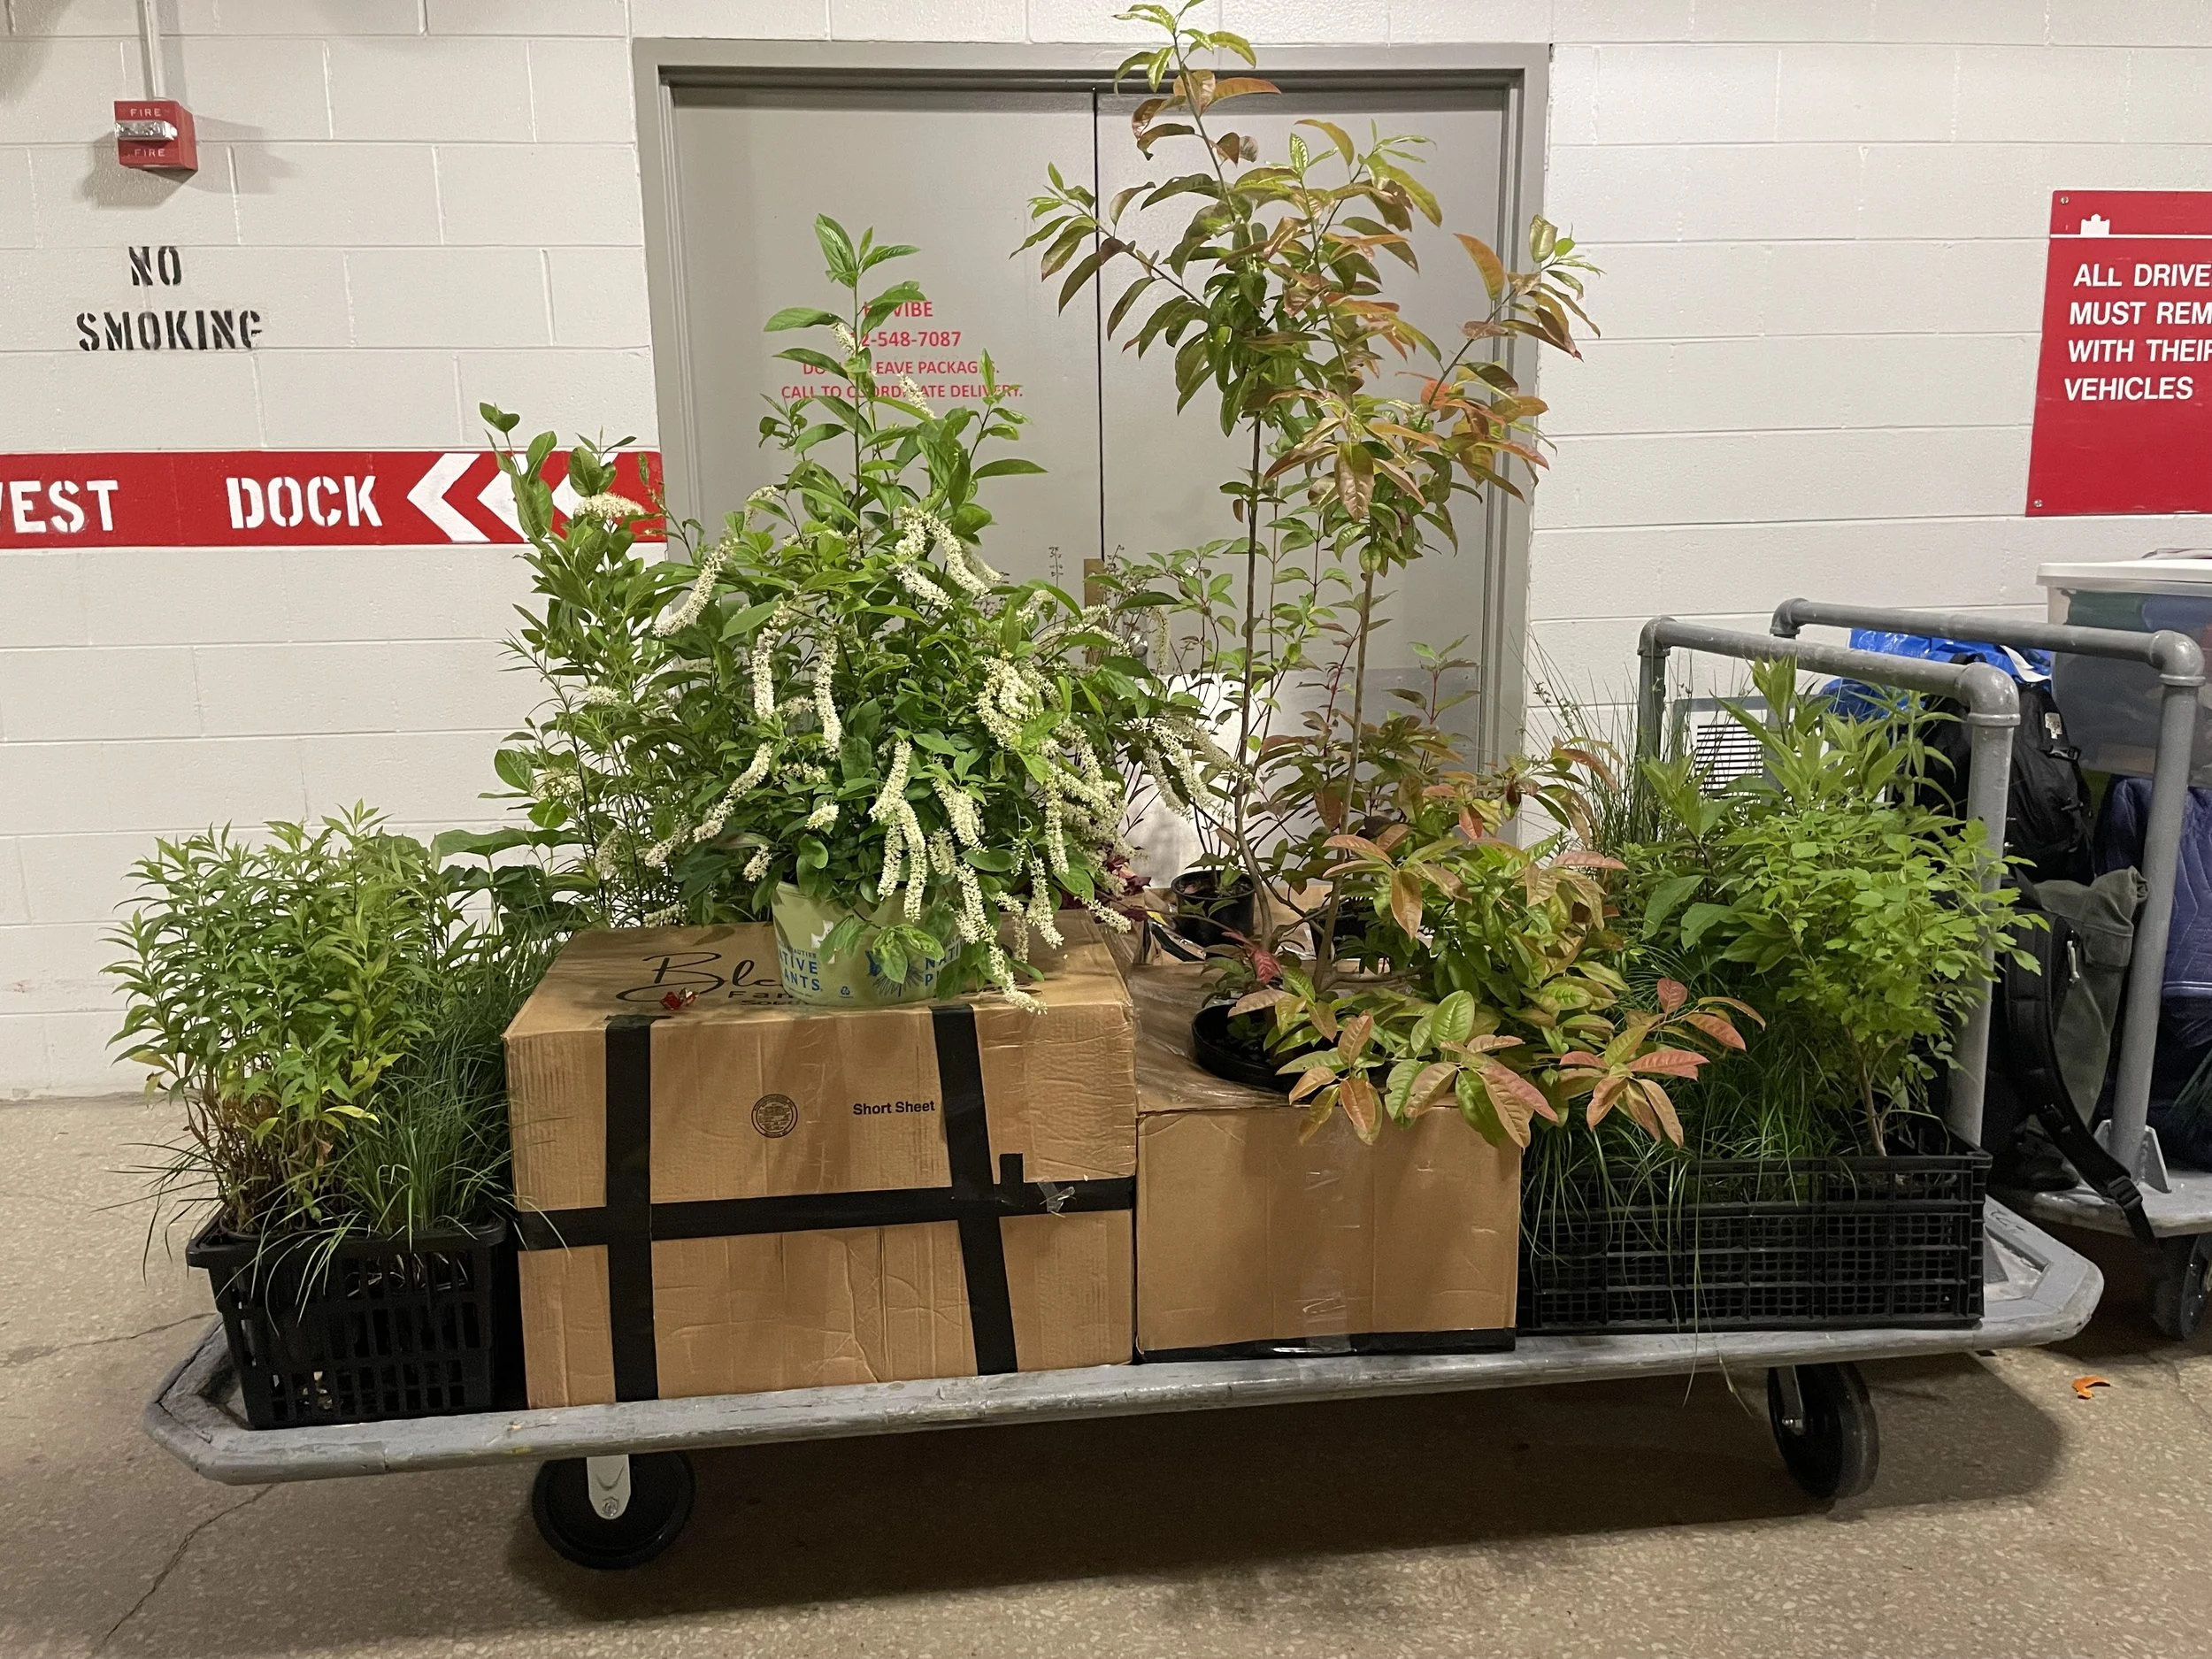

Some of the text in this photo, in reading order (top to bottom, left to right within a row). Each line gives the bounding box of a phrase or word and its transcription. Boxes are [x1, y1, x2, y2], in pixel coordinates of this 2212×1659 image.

[129, 108, 162, 117] FIRE
[128, 246, 182, 286] NO
[2073, 263, 2212, 288] ALL DRIVE
[2069, 301, 2212, 326] MUST REM
[76, 310, 263, 351] SMOKING
[850, 330, 962, 347] 2-548-7087
[2068, 340, 2134, 363] WITH
[869, 361, 914, 374] EAVE
[918, 361, 1000, 374] PACKAG.
[2064, 376, 2193, 401] VEHICLES
[0, 475, 383, 534] EST DOCK
[784, 967, 821, 991] ANTS
[852, 1100, 935, 1115] Short Sheet
